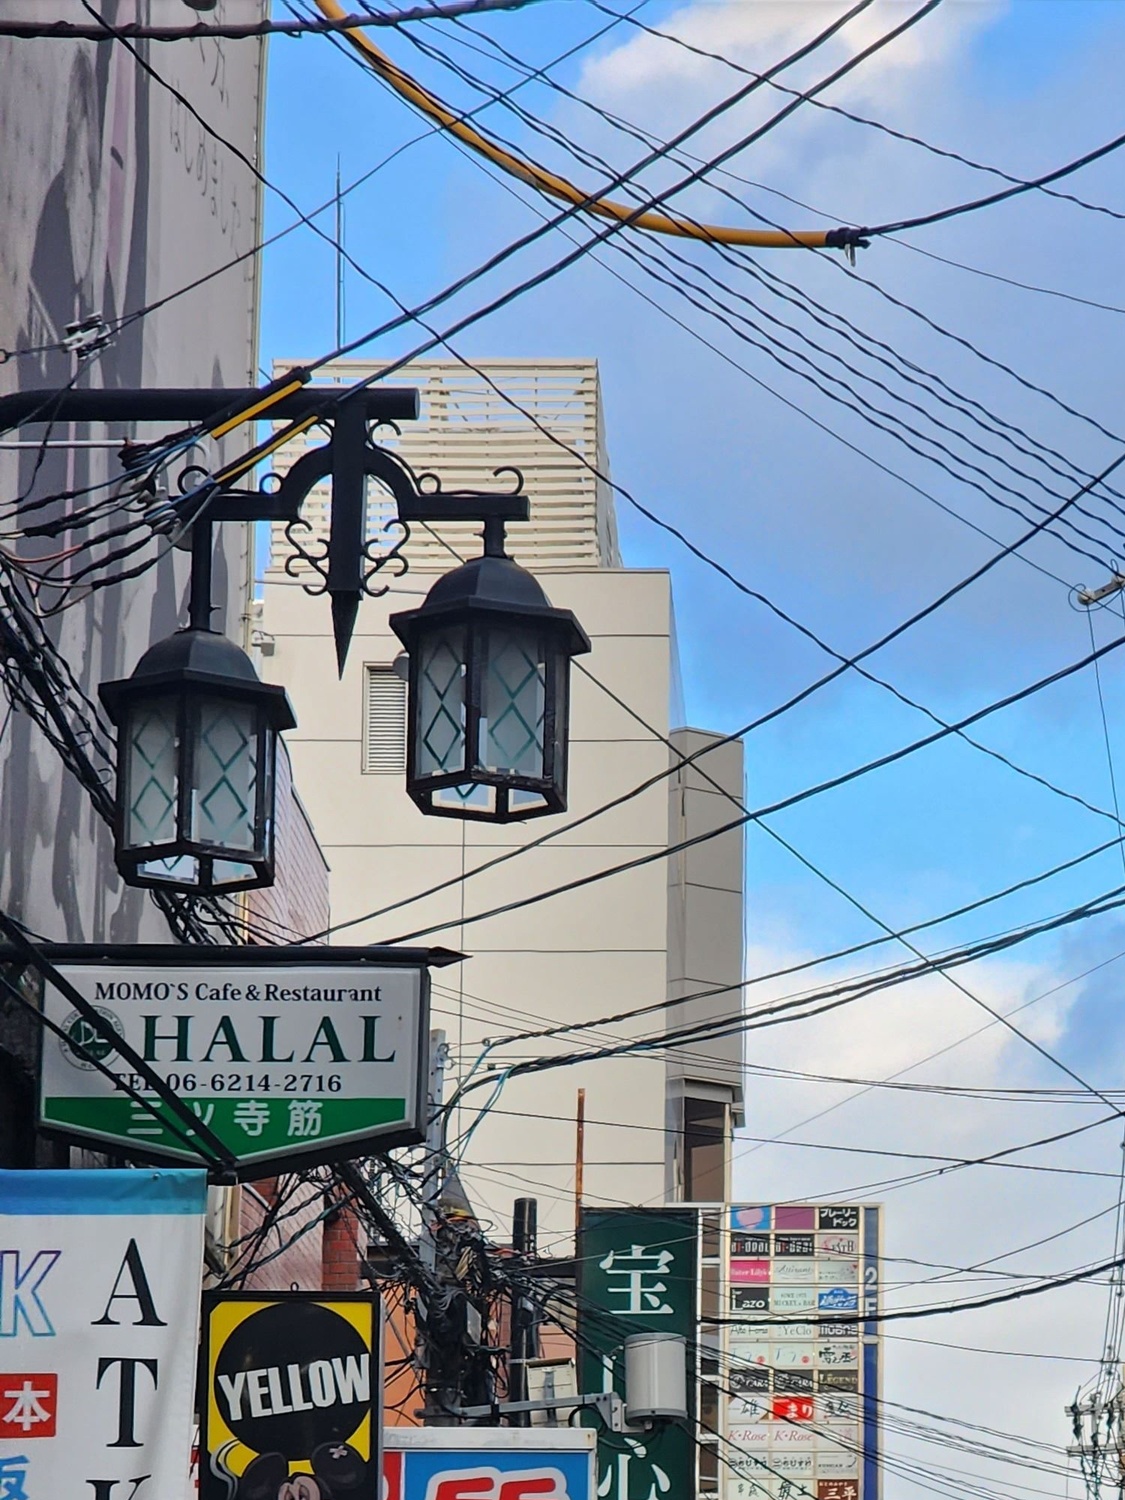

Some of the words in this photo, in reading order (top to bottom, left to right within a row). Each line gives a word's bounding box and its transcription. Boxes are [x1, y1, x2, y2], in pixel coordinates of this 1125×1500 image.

[195, 982, 241, 1001] Cafe
[245, 985, 261, 1000] &
[264, 983, 382, 1002] Restaurant
[140, 1015, 397, 1063] HALAL
[166, 1073, 342, 1093] 06-6214-2716
[127, 1101, 323, 1137] 三ツ寺筋
[217, 1353, 372, 1422] YELLOW
